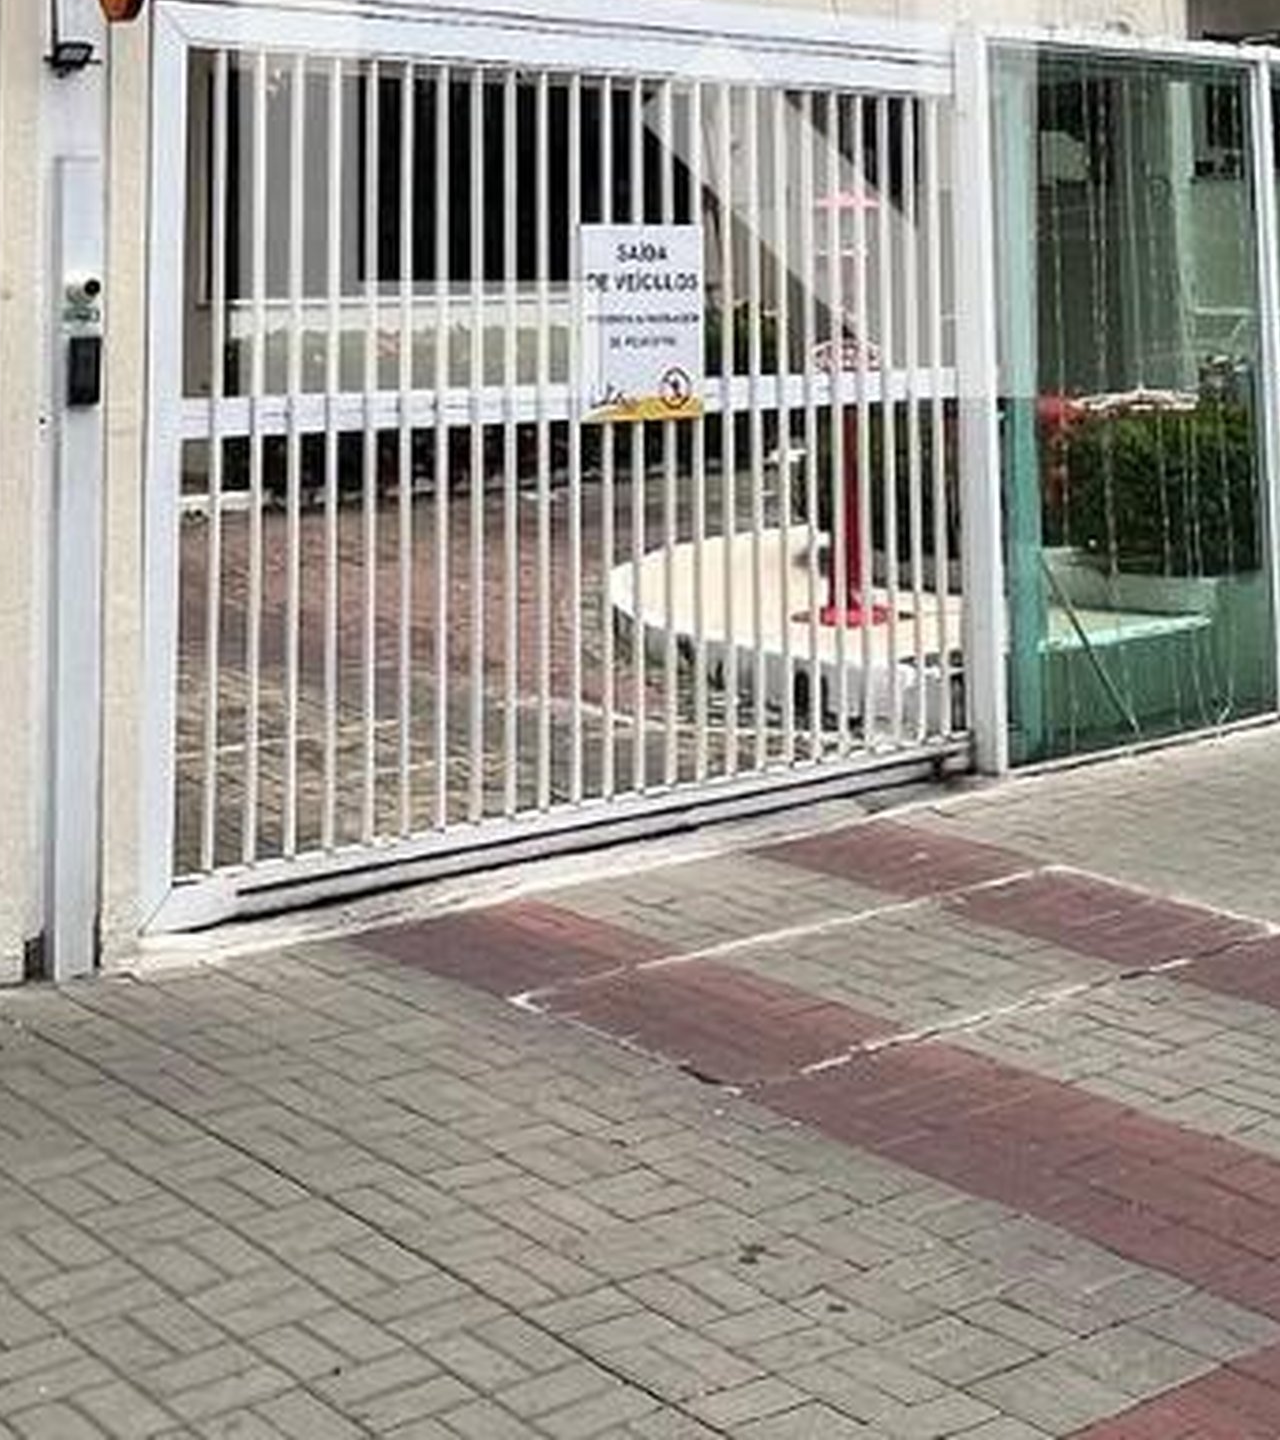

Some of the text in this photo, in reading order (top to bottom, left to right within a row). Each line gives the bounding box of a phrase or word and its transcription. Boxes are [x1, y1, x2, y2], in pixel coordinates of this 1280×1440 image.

[616, 241, 668, 263] SAÍDA
[587, 268, 699, 292] DE VEÍCULOS
